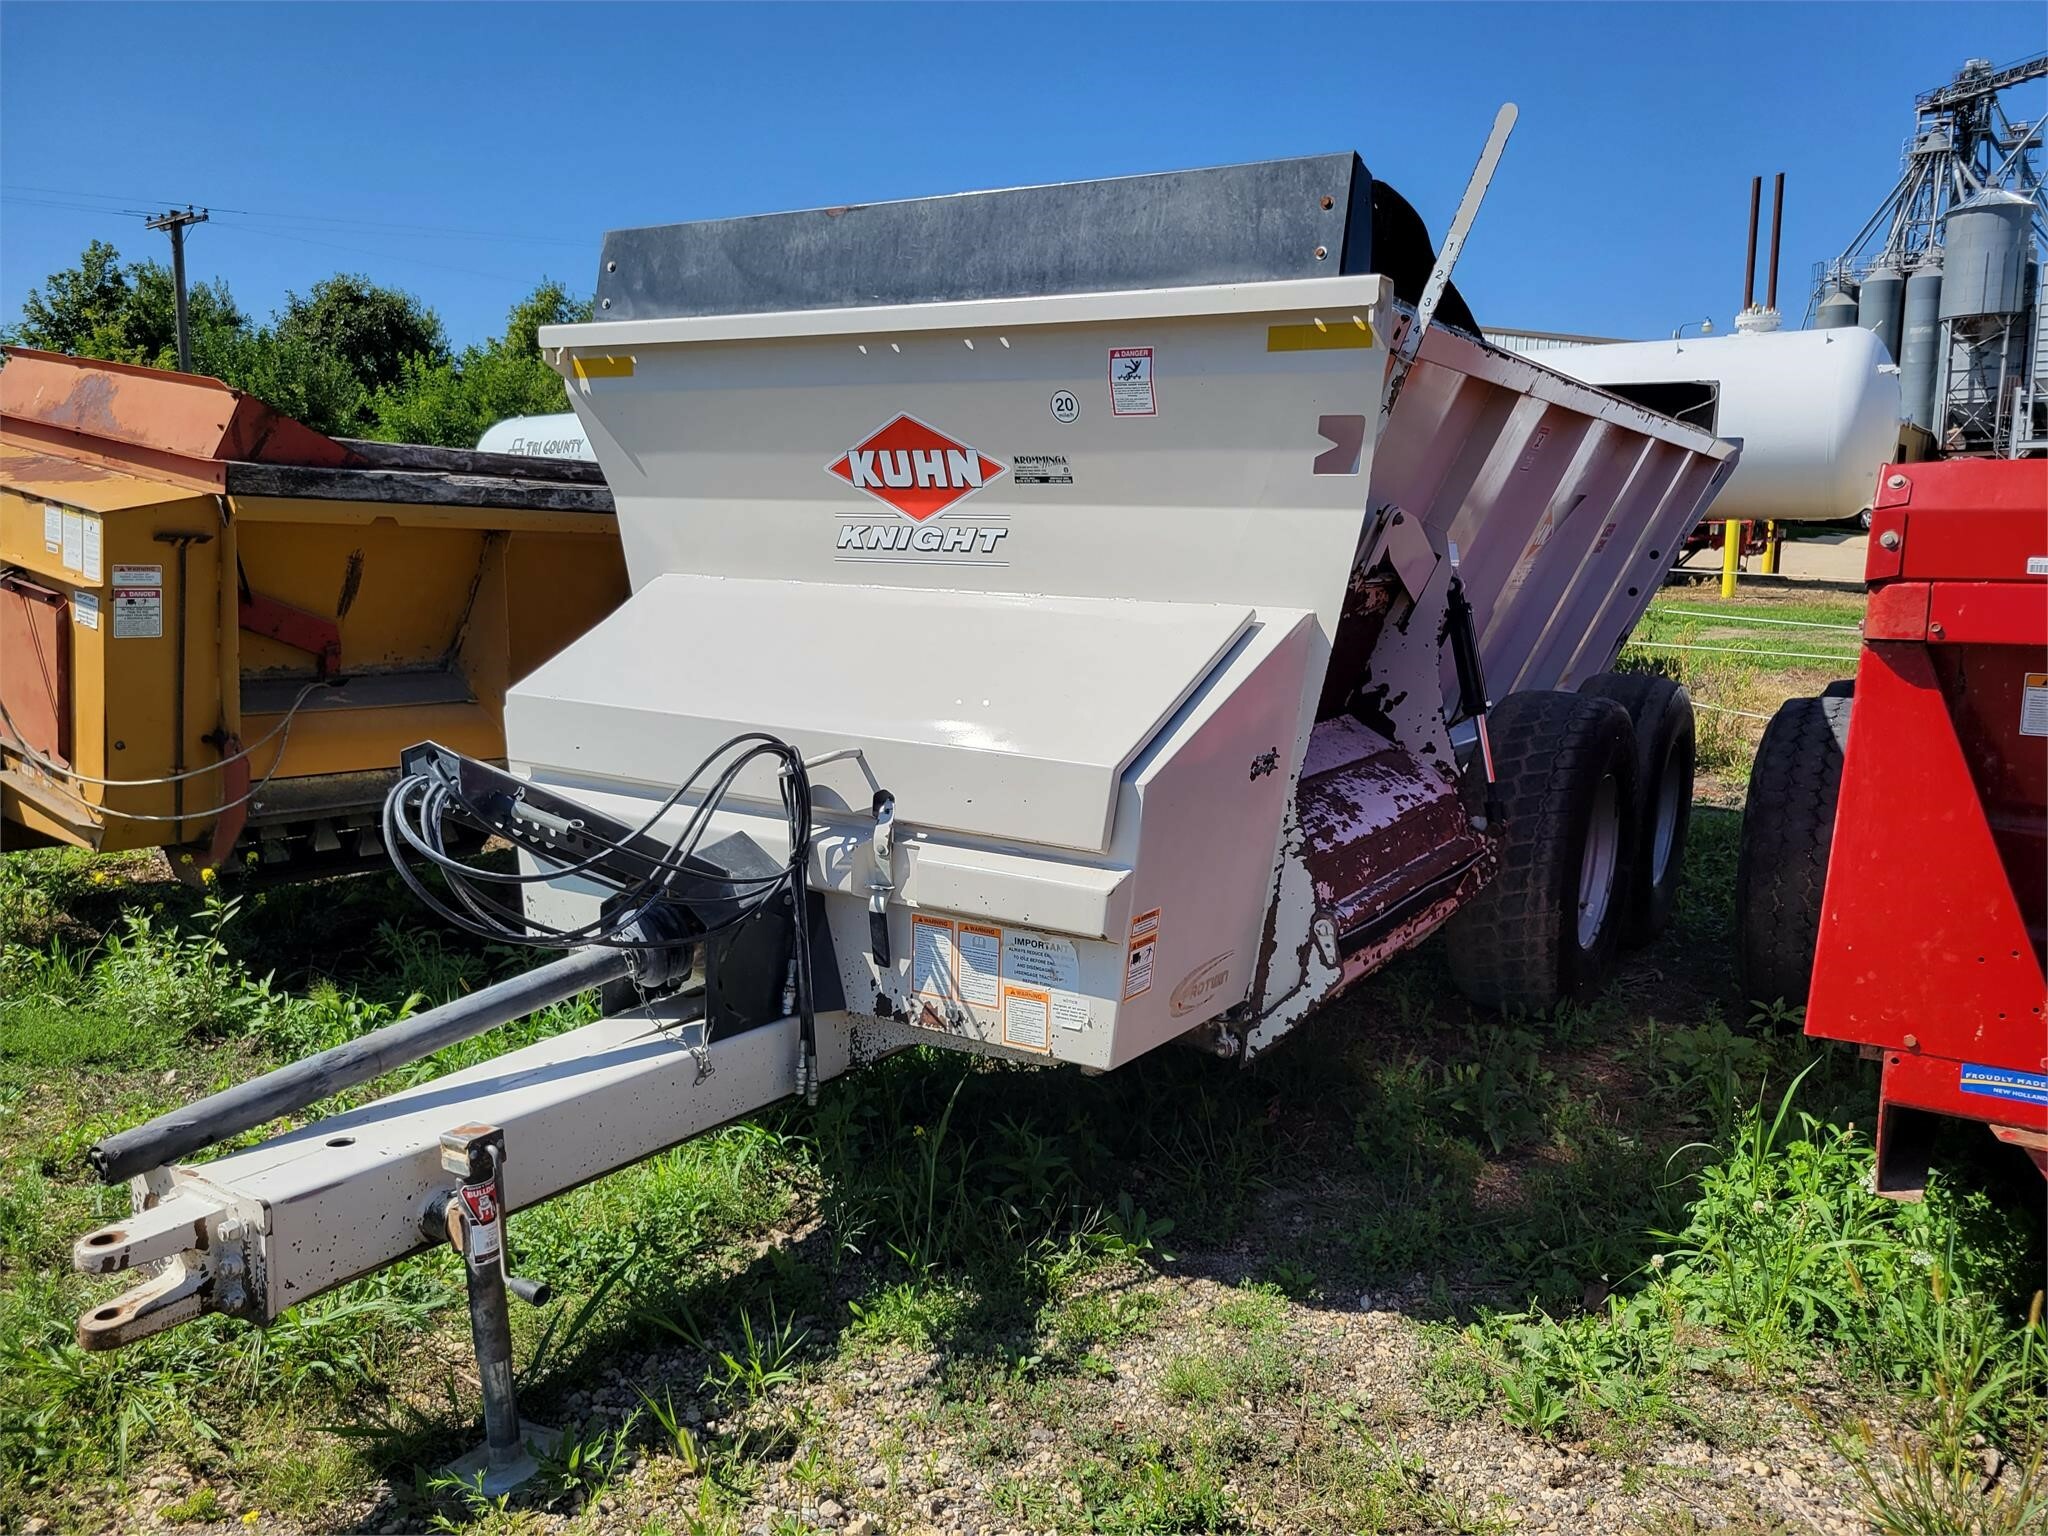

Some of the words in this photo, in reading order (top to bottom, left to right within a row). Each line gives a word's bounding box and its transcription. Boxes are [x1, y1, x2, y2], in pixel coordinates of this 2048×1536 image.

[1448, 242, 1454, 251] 1
[1435, 269, 1443, 279] 2
[1424, 297, 1432, 307] 3
[1413, 325, 1420, 334] 4
[1055, 397, 1074, 411] 20
[526, 441, 542, 456] TRI
[543, 439, 584, 455] COUNTY
[1014, 456, 1067, 465] KROMMINGA
[847, 449, 983, 488] KUHN
[836, 525, 1008, 553] KNIGHT
[925, 918, 948, 927] WARNING
[970, 926, 995, 935] WARNING
[1014, 937, 1069, 953] IMPORTANT
[1030, 957, 1046, 965] BEFORE
[1017, 990, 1042, 999] WARNING
[1965, 1073, 2013, 1083] PROUDLY
[2017, 1078, 2047, 1088] MADE
[1993, 1087, 2011, 1095] NEW
[2012, 1091, 2048, 1102] HOLLAND
